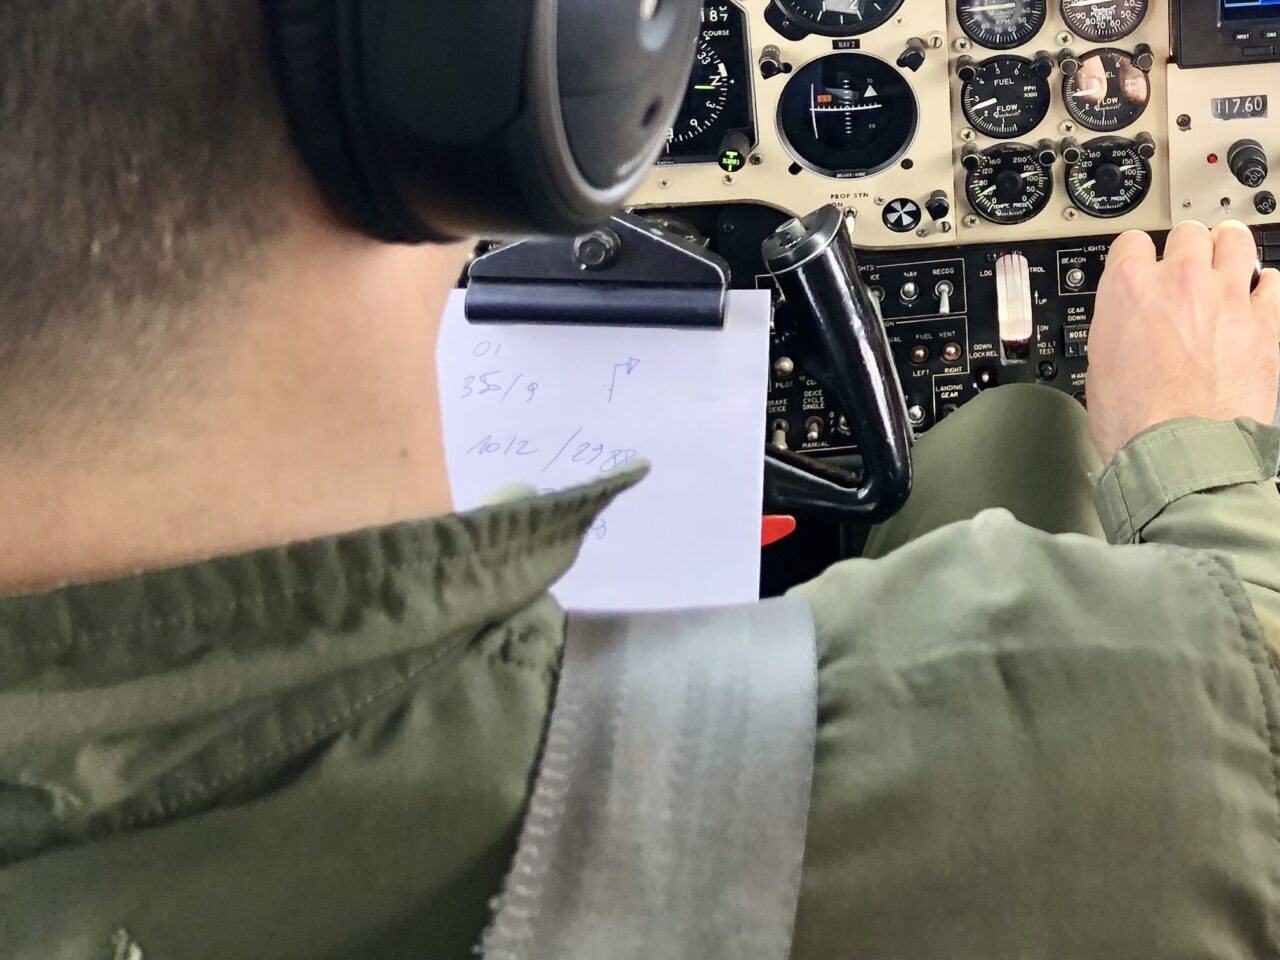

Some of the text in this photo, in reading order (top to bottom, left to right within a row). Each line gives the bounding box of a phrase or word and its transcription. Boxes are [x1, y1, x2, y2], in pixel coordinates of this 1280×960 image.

[1216, 98, 1263, 114] 117.60
[1083, 245, 1106, 253] LIGHTS
[1067, 314, 1087, 322] DOWN
[944, 366, 963, 374] RIGHT
[935, 384, 963, 392] LANDING
[804, 389, 823, 397] DEICE
[941, 391, 959, 399] GEAR
[802, 403, 825, 411] SINGLE
[802, 441, 829, 449] MANUAL
